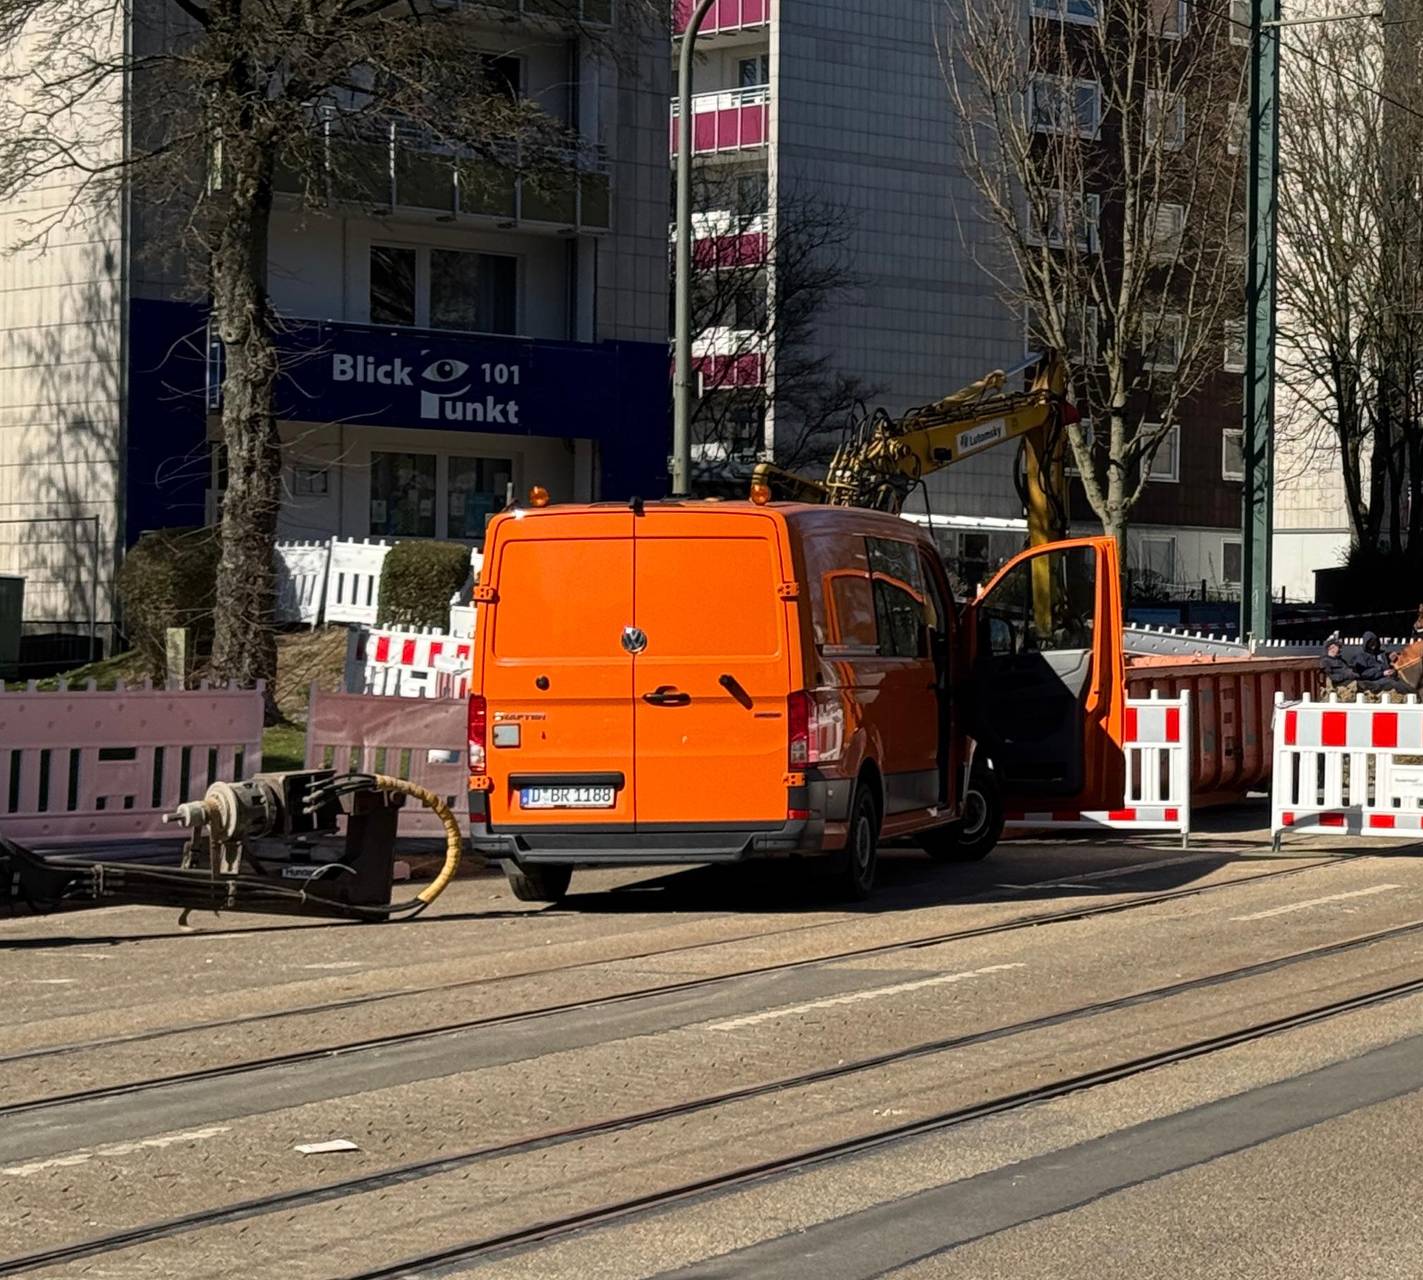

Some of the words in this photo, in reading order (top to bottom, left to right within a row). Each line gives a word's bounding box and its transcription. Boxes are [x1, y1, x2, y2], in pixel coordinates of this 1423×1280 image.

[333, 354, 414, 386] Blick
[481, 363, 520, 385] 101
[531, 787, 541, 802] D
[550, 787, 570, 802] BR
[575, 787, 612, 802] 1188
